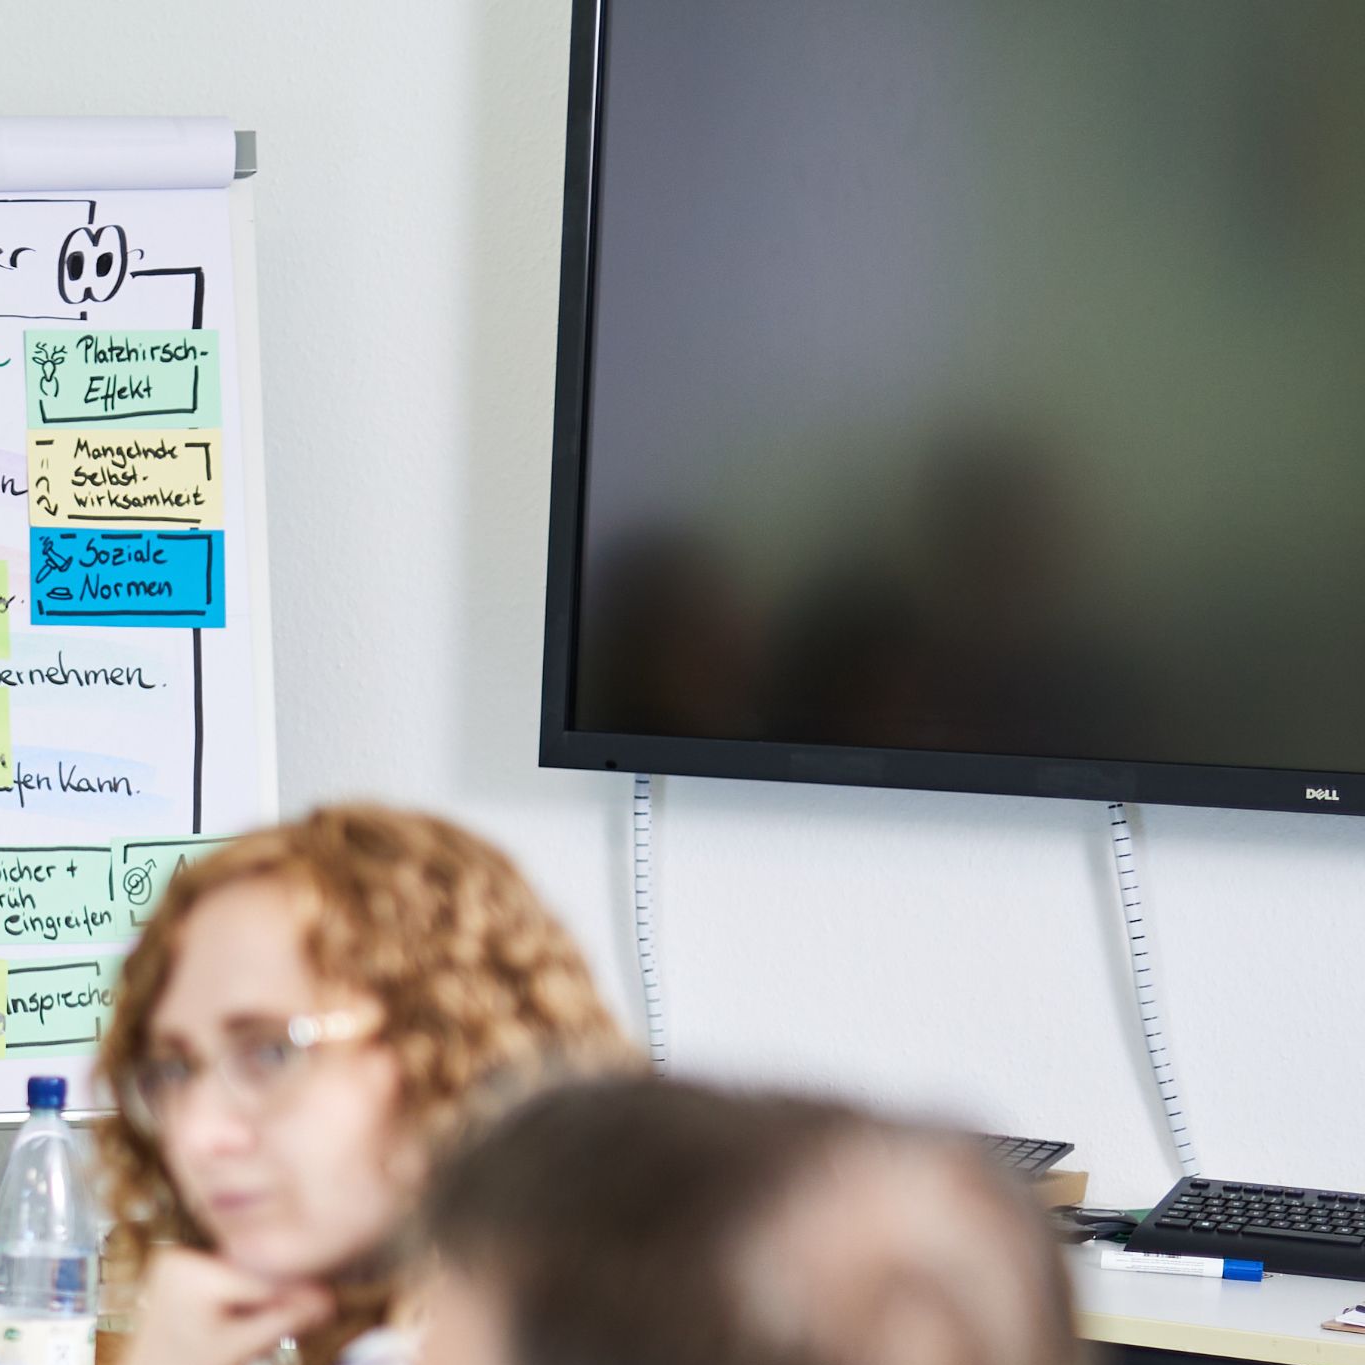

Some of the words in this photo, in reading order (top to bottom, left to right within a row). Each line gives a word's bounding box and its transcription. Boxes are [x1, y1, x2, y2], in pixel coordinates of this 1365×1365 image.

[84, 375, 153, 412] Effekt
[73, 438, 179, 469] Mangelnde
[74, 485, 206, 511] wirksamkeit
[78, 537, 168, 569] Soziale
[80, 573, 173, 601] Normen
[1305, 788, 1340, 801] DELL
